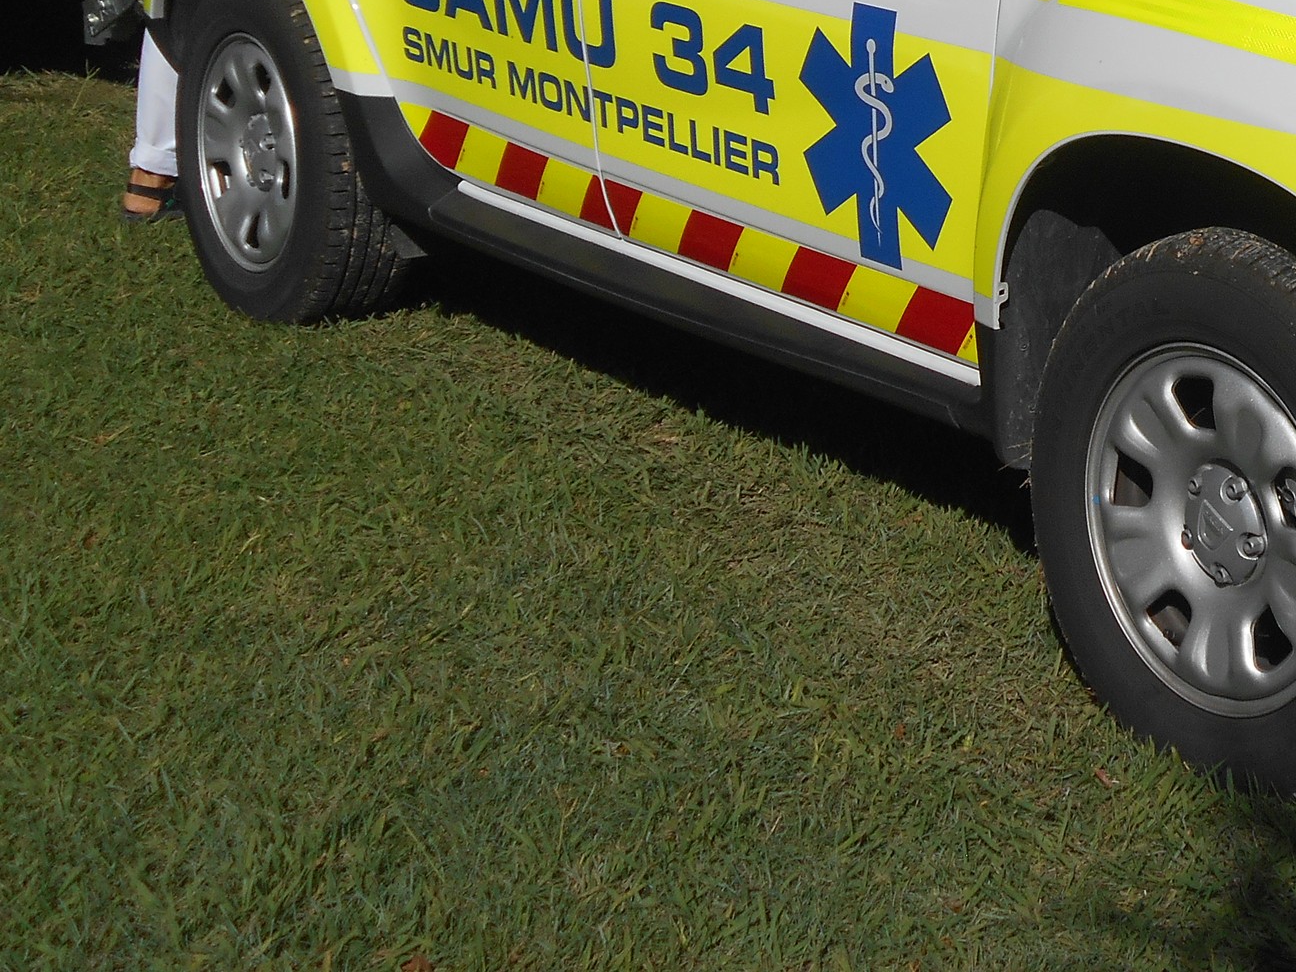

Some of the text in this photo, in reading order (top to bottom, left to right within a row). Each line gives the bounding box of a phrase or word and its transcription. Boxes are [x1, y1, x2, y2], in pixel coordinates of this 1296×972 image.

[402, 26, 781, 187] SMUR MONTPELLIER
[650, 1, 776, 116] 34
